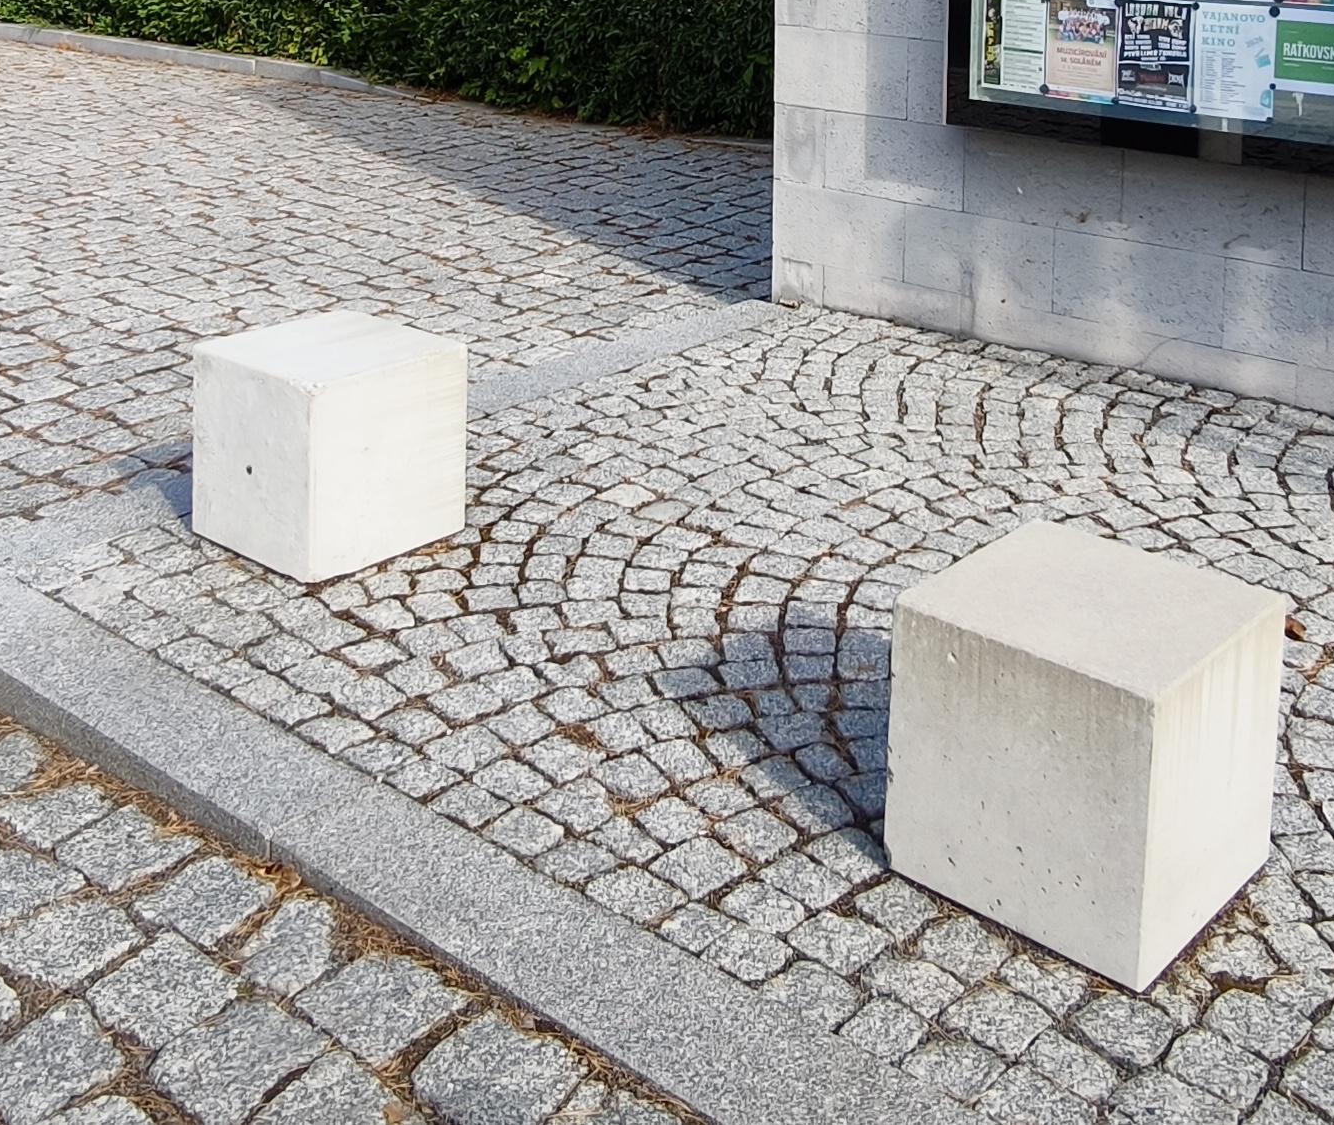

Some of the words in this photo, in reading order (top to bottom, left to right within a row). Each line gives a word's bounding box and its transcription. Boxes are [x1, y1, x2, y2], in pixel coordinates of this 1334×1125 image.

[1202, 10, 1266, 24] VAJANOVO
[1202, 24, 1240, 35] LETNÍ
[1202, 36, 1236, 48] KINO
